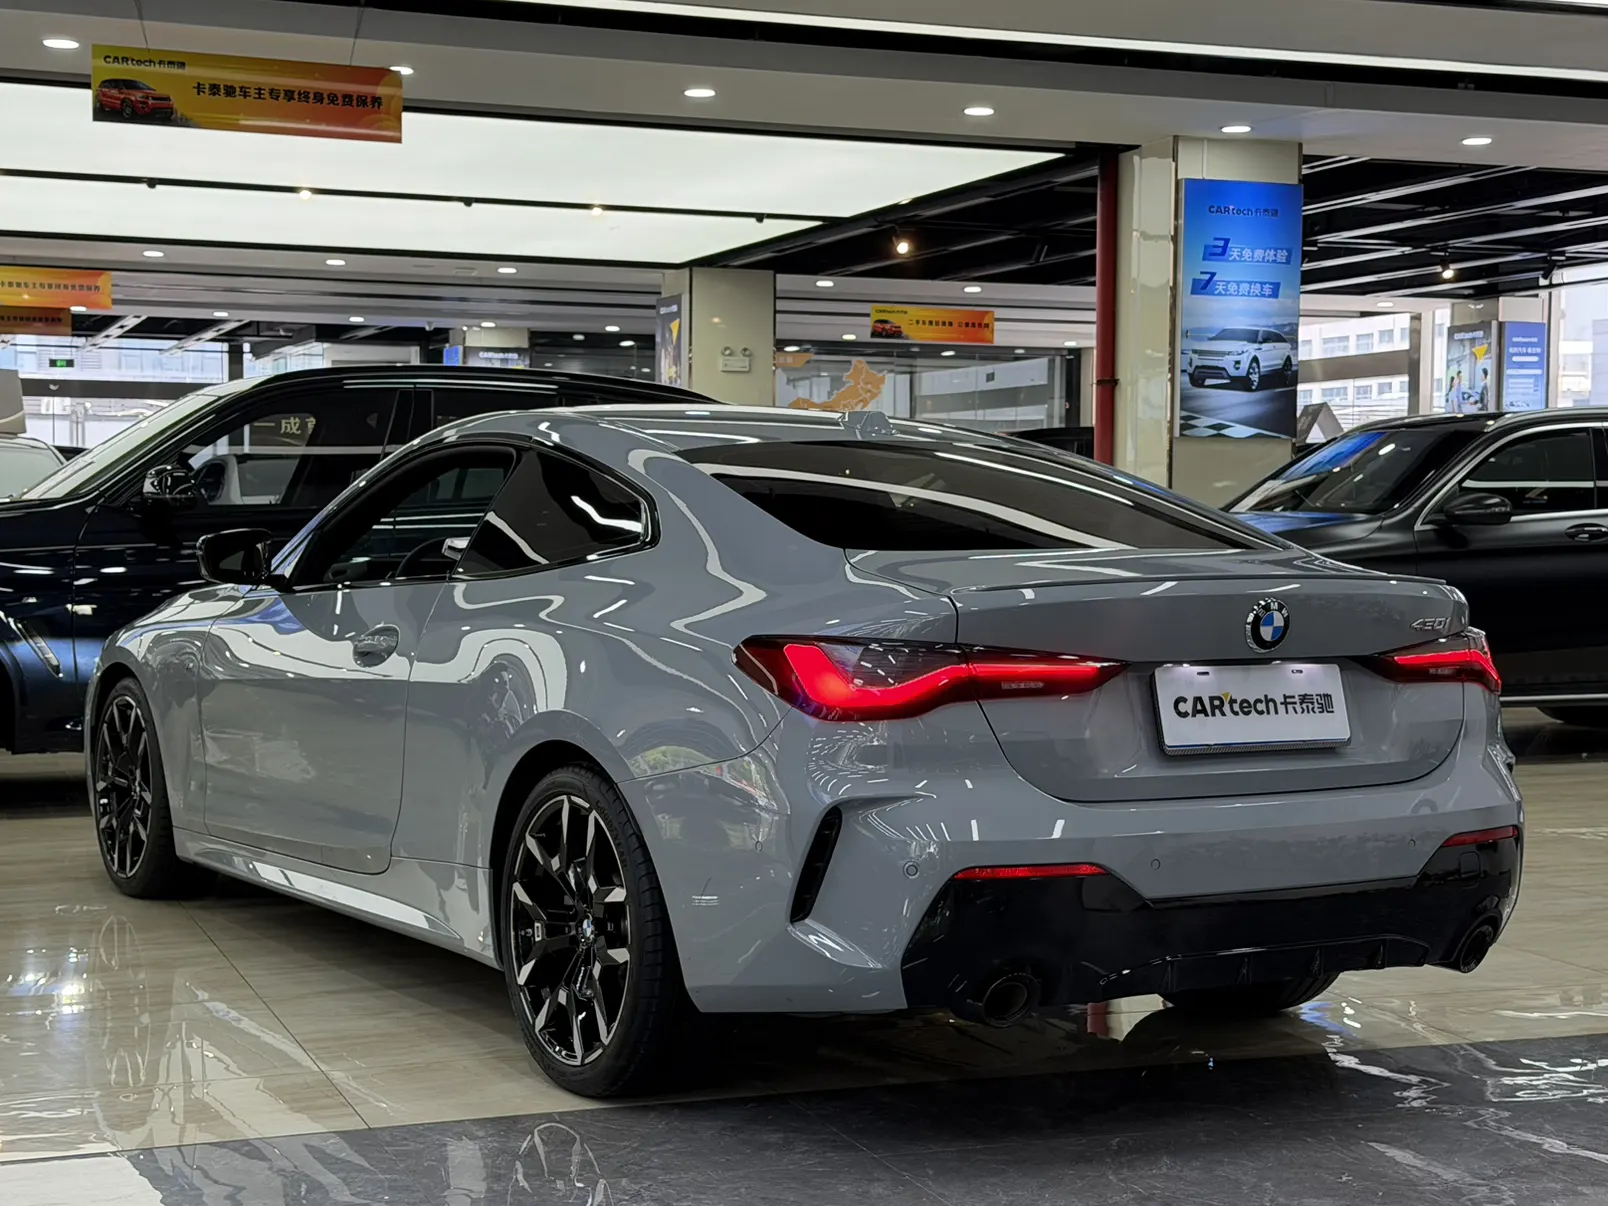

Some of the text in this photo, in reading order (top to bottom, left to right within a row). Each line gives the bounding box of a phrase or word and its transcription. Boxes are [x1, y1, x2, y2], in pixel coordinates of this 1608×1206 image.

[193, 82, 384, 110] 卡泰驰车主专享终身免费保养
